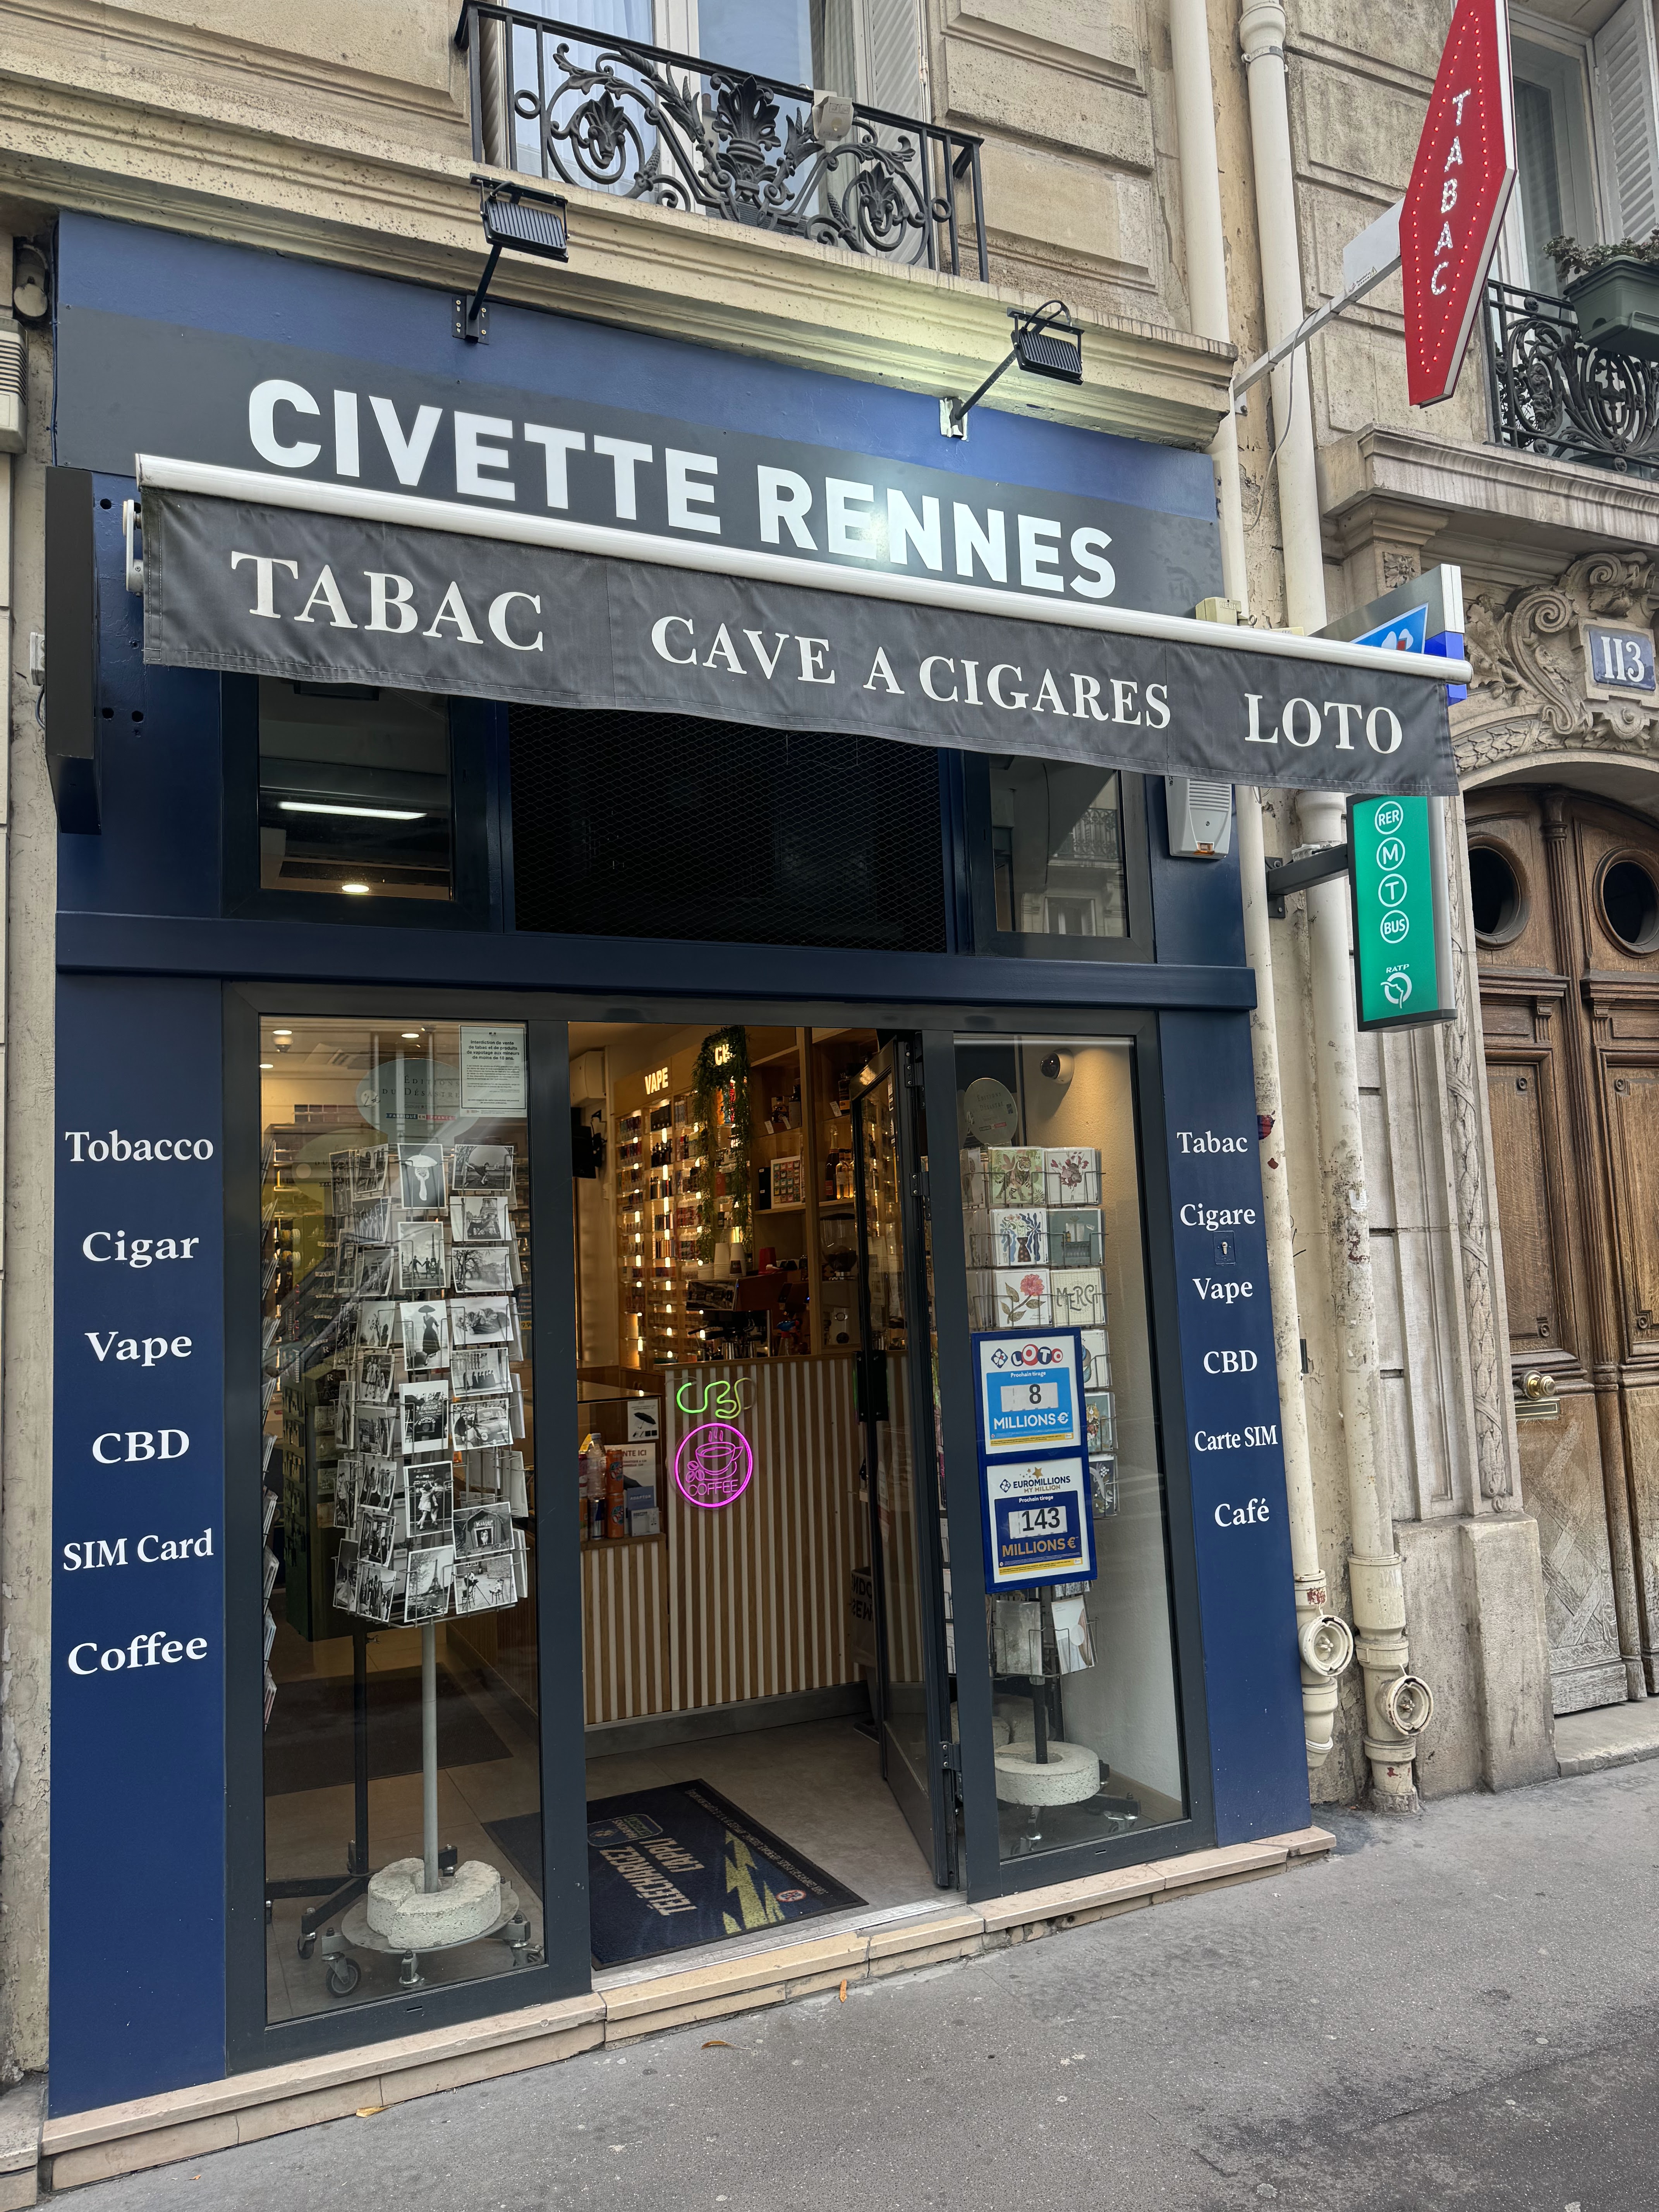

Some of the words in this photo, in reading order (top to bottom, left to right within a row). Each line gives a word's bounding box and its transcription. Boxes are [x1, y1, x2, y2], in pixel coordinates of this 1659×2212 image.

[1431, 88, 1471, 295] TABAC
[249, 379, 721, 534] CIVETTE
[757, 465, 1116, 598] RENNES
[231, 551, 544, 651] TABAC
[1220, 602, 1238, 610] NEON
[651, 615, 836, 684] CAVE
[863, 646, 905, 694] A
[919, 655, 1171, 728] CIGARES
[1601, 637, 1645, 682] 113
[1245, 693, 1402, 754] LOTO
[1379, 810, 1399, 826] RER
[1382, 844, 1398, 864] M
[1385, 881, 1399, 900] T
[1384, 919, 1405, 934] BUS
[1386, 964, 1409, 973] RATP
[644, 1067, 668, 1094] VAPE
[65, 1129, 213, 1161] Tobacco
[1177, 1130, 1248, 1153] Tabac
[1180, 1203, 1255, 1231] Cigare
[82, 1230, 199, 1268] Cigar
[1056, 1285, 1098, 1311] MERCI
[1192, 1278, 1253, 1304] Vape
[84, 1331, 192, 1366] Vape
[1012, 1345, 1063, 1366] LOTO
[1204, 1350, 1257, 1374] CBD
[1029, 1384, 1041, 1404] 8
[994, 1413, 1056, 1430] MILLIONS
[92, 1429, 189, 1464] CBD
[1195, 1431, 1241, 1451] Carte
[1245, 1425, 1278, 1447] SIM
[687, 1479, 738, 1496] COFFEE
[1013, 1476, 1070, 1489] EUROMILLIONS
[1022, 1508, 1060, 1532] 143
[1215, 1498, 1269, 1527] Café
[64, 1538, 128, 1571] SIM
[137, 1528, 213, 1563] Card
[1002, 1538, 1065, 1557] MILLIONS
[68, 1631, 207, 1674] Coffee
[639, 1838, 704, 1872] L'APPLI
[599, 1846, 697, 1915] TÉLÉCHARGEZ
